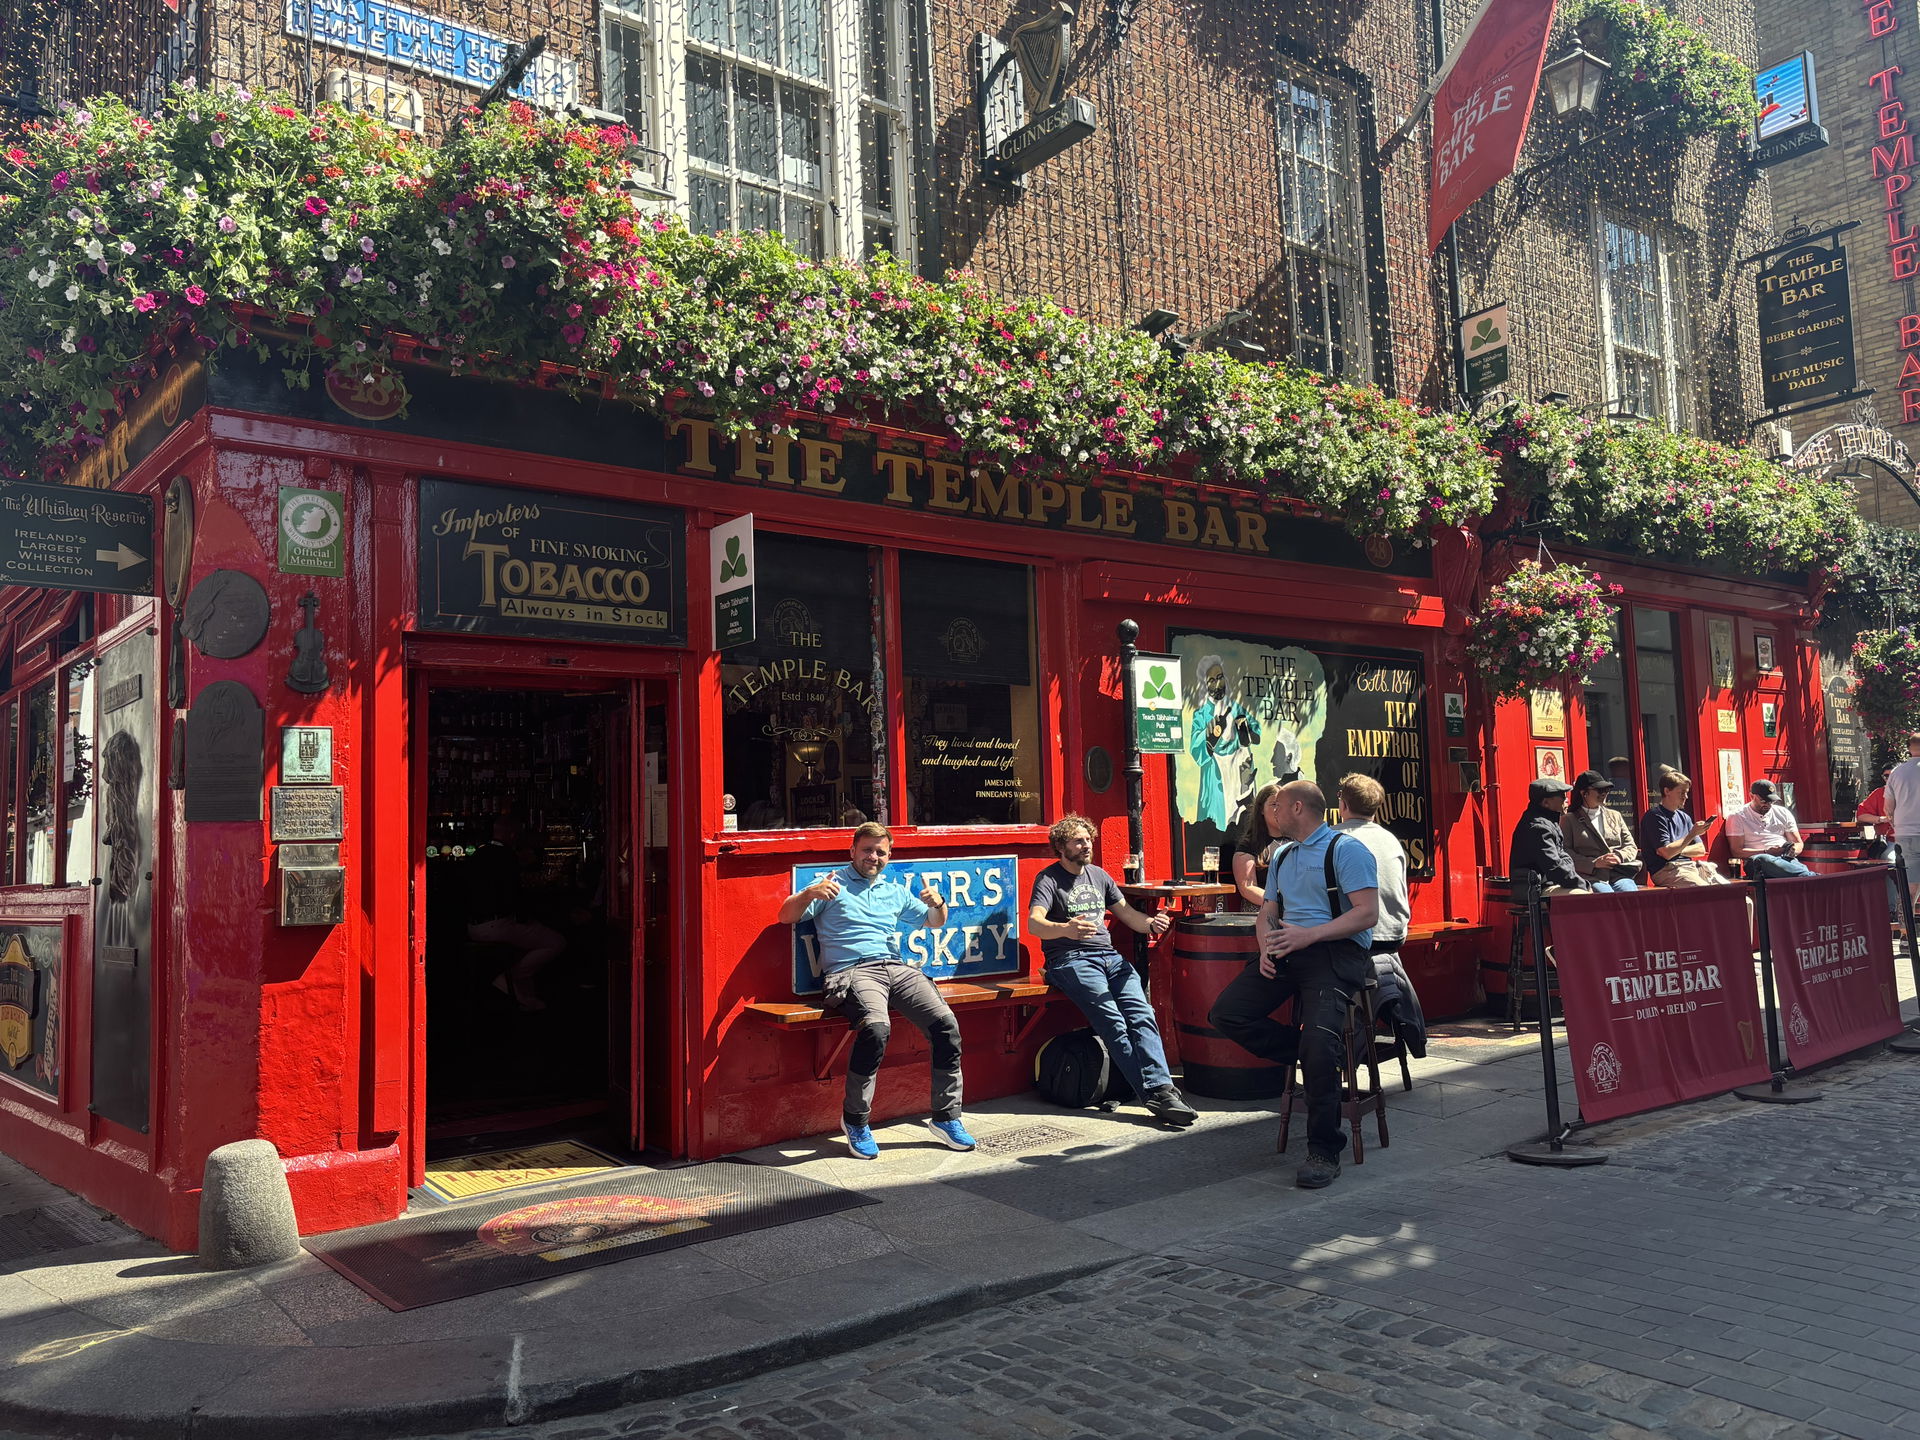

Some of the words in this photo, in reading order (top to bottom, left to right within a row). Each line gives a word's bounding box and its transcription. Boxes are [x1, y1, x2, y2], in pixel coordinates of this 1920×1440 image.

[293, 8, 385, 48] TEMPLE
[397, 38, 456, 70] LANE
[369, 6, 456, 49] TEMPLE
[1452, 86, 1482, 131] THE
[1001, 108, 1070, 160] GUINNESS
[1757, 127, 1819, 161] GUINNESS
[1439, 133, 1476, 189] BAR
[1868, 65, 1920, 282] TEMPLE
[1787, 253, 1815, 269] THE
[1760, 258, 1844, 293] TEMPLE
[1781, 283, 1827, 306] BAR
[1766, 329, 1800, 345] BEER
[1797, 315, 1845, 336] GARDEN
[1771, 367, 1801, 383] LIVE
[1802, 355, 1845, 375] MUSIC
[1788, 373, 1828, 391] DAILY
[669, 416, 847, 493] THE
[874, 450, 1137, 535] TEMPLE
[1163, 499, 1271, 553] BAR
[4, 496, 22, 511] The
[21, 493, 89, 523] Whiskey
[91, 503, 146, 528] Reserve
[431, 503, 541, 541] Importers
[14, 528, 87, 544] IRELAND'S
[501, 526, 520, 539] OF
[18, 551, 83, 565] WHISKEY
[20, 540, 82, 554] LARGEST
[293, 546, 331, 558] Official
[529, 538, 569, 556] FINE
[573, 543, 649, 565] SMOKING
[6, 560, 94, 576] COLLECTION
[290, 555, 334, 568] Member
[462, 541, 651, 608] TOBACCO
[503, 599, 576, 619] Always
[586, 607, 603, 621] in
[612, 608, 666, 627] Stock
[789, 631, 822, 648] THE
[1260, 654, 1297, 678] THE
[728, 658, 827, 705] TEMPLE
[835, 668, 878, 716] BAR
[1242, 675, 1315, 701] TEMPLE
[1391, 669, 1418, 695] 1840
[806, 693, 825, 702] 1840
[1142, 713, 1155, 721] Teach
[1263, 699, 1301, 724] BAR
[1384, 700, 1417, 729] THE
[1836, 709, 1851, 724] BAR
[950, 735, 975, 748] lived
[975, 737, 994, 750] and
[994, 738, 1021, 750] loved
[1346, 728, 1421, 759] EMPEROR
[921, 754, 941, 766] and
[942, 754, 979, 770] laughed
[980, 755, 999, 768] and
[1402, 761, 1420, 789] OF
[975, 790, 1013, 798] FINNEGAN'S
[1014, 791, 1031, 799] WAKE
[984, 779, 1004, 787] JAMES
[1004, 778, 1023, 787] JOYCE
[1818, 924, 1838, 942] THE
[1644, 950, 1679, 971] THE
[1796, 942, 1840, 971] TEMPLE
[1842, 935, 1868, 960] BAR
[1605, 972, 1682, 1005] TEMPLE
[1682, 964, 1722, 994] BAR
